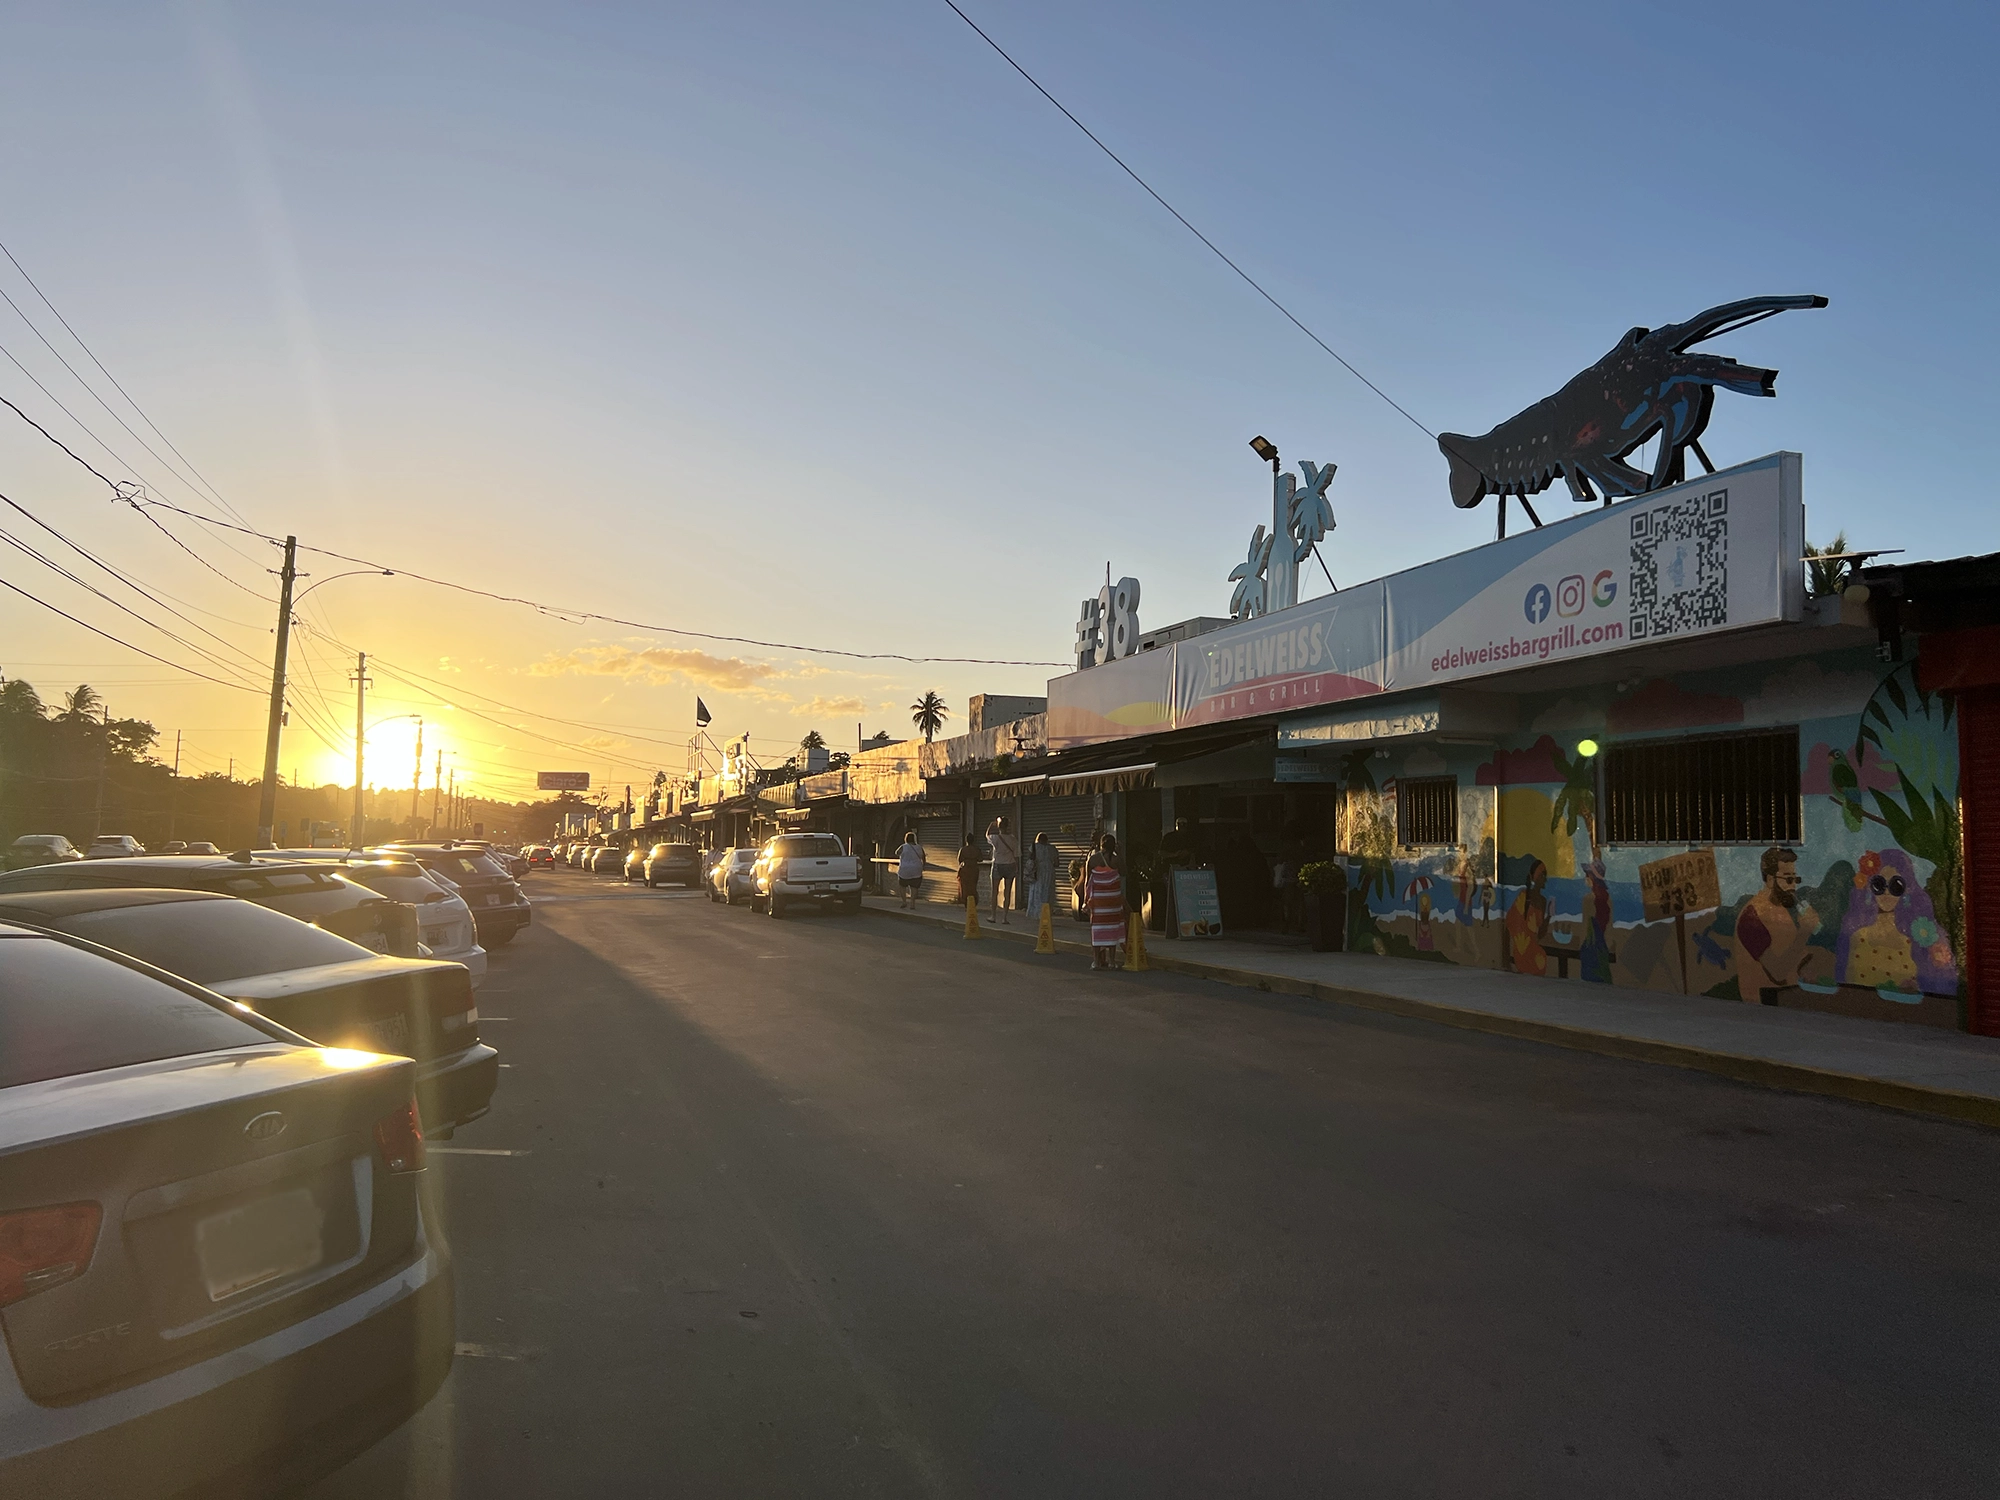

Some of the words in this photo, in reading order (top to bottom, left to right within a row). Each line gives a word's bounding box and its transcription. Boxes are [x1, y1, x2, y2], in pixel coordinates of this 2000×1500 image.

[1075, 577, 1140, 670] #38
[1431, 621, 1623, 671] edelweissbargrill.com
[1210, 622, 1322, 687] EDELWEISS
[1211, 695, 1235, 713] BAR
[1249, 691, 1255, 705] &
[1269, 680, 1320, 701] GRILL
[1660, 882, 1698, 914] #38
